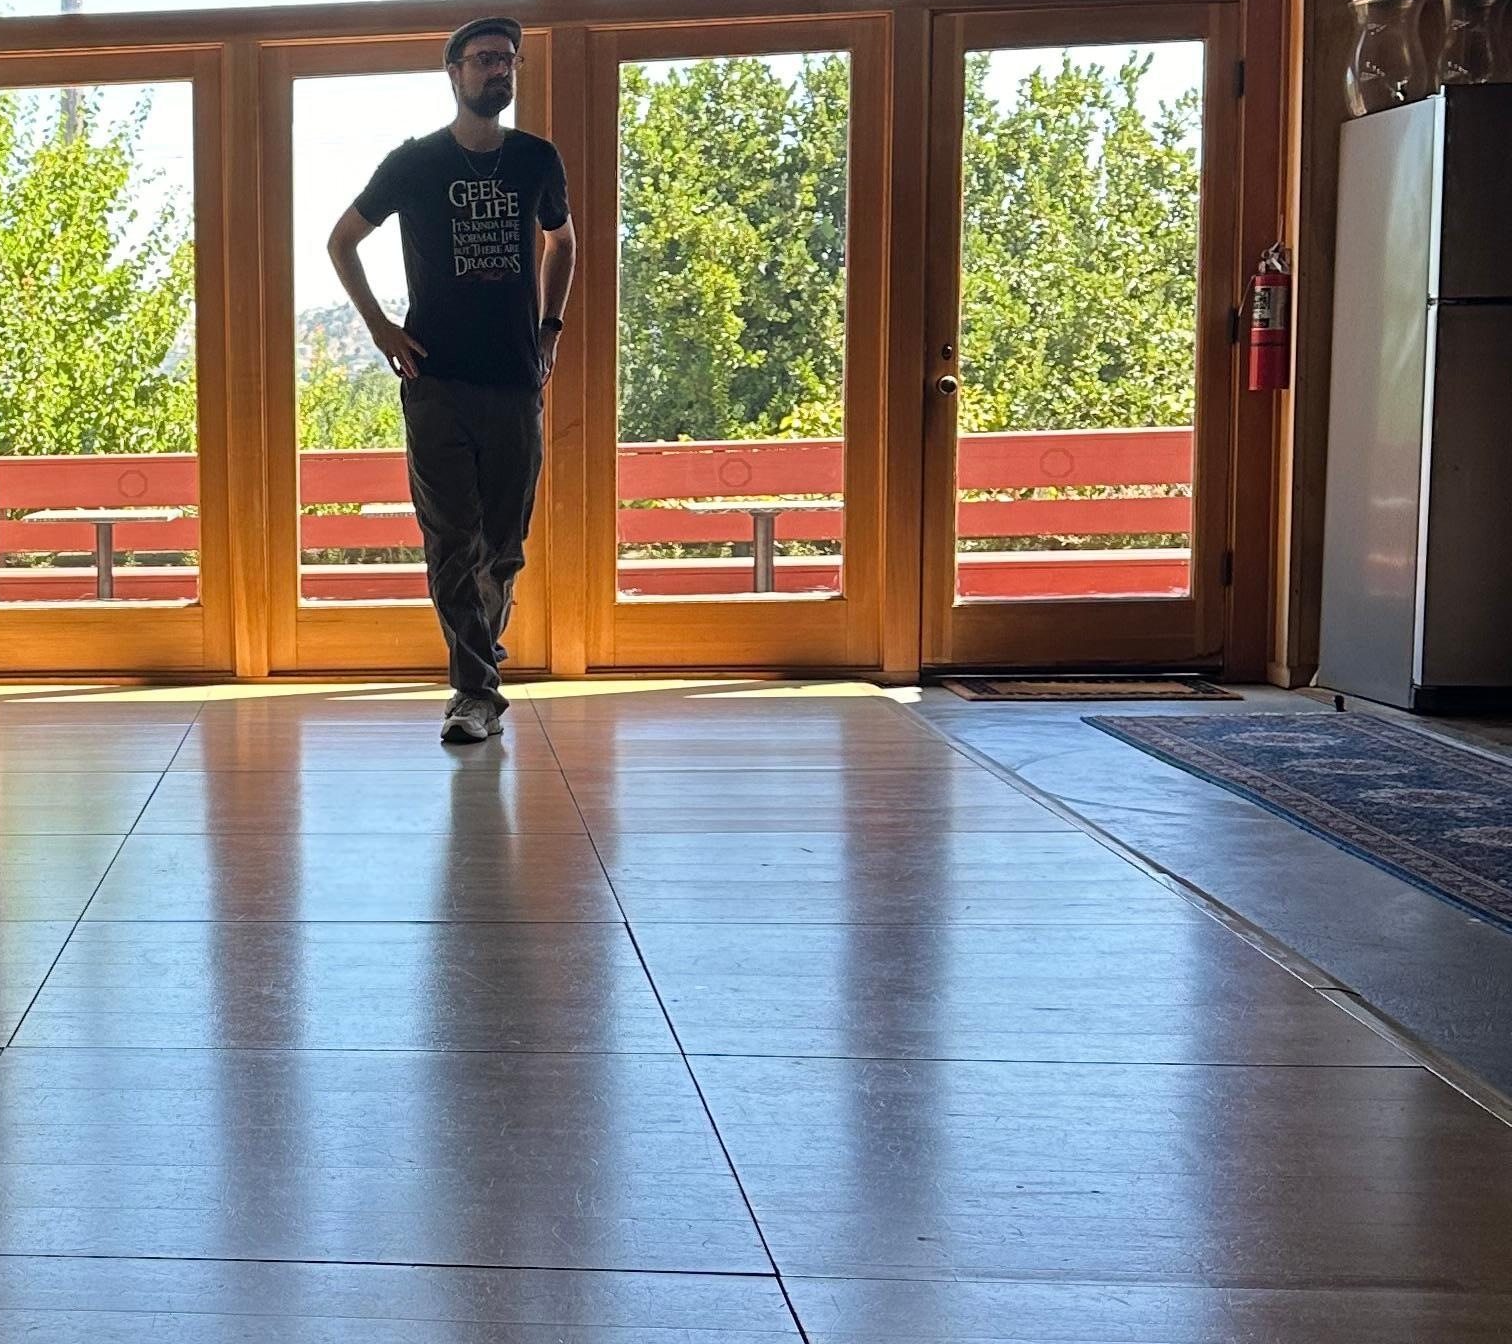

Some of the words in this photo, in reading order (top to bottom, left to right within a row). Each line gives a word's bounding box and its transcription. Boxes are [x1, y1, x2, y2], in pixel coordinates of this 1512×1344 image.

[448, 180, 506, 207] GEEK
[471, 192, 520, 219] LIFE
[471, 220, 500, 232] KINDA
[452, 233, 498, 246] NORMAL
[501, 229, 520, 244] LIFE
[453, 245, 471, 256] BUT
[471, 244, 503, 257] THERE
[503, 244, 520, 254] ARE
[455, 254, 521, 276] DRAGONS
